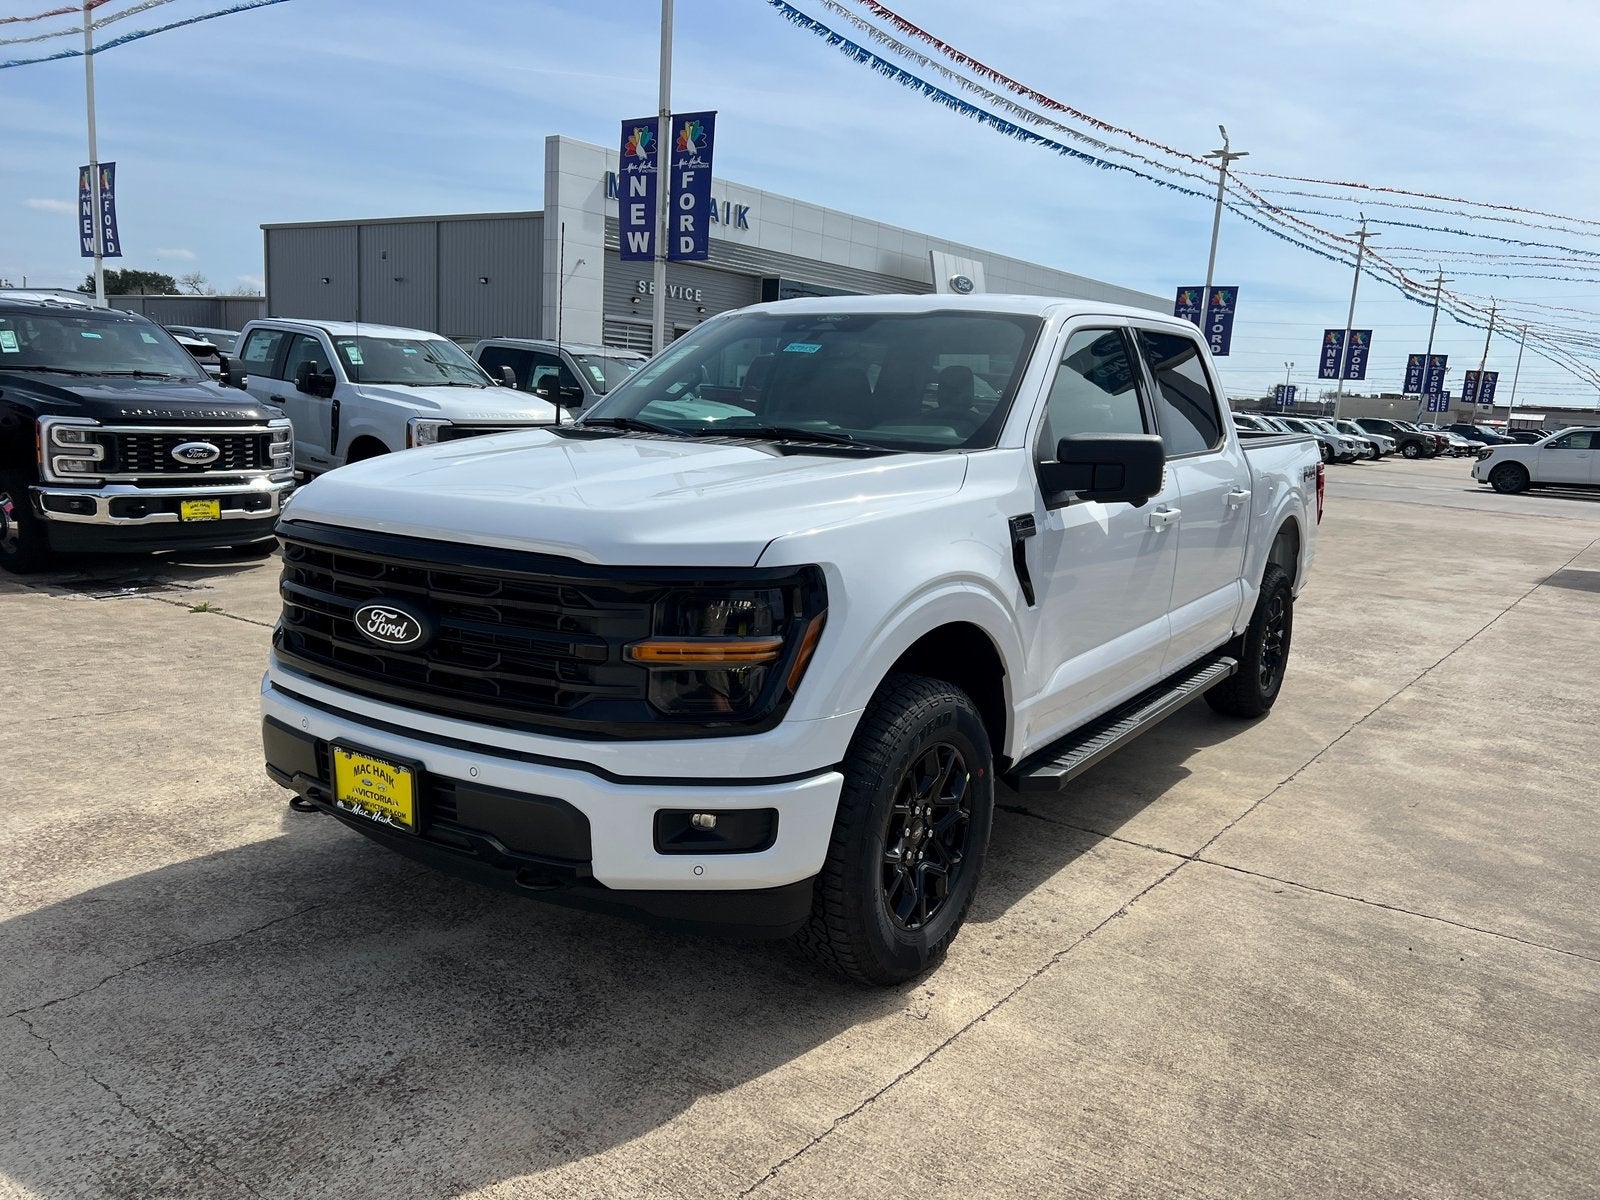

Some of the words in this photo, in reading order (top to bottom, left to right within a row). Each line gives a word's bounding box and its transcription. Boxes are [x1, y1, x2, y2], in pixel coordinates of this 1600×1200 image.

[82, 201, 94, 252] NEW
[627, 175, 650, 253] NEW
[679, 171, 695, 253] FORD
[709, 197, 750, 231] AIK
[104, 201, 115, 253] FORD
[638, 280, 702, 302] SEVICE
[1210, 313, 1225, 353] FORD
[1323, 348, 1336, 377] NEW
[1349, 349, 1362, 378] FORD
[1408, 369, 1419, 391] NEW
[1429, 369, 1439, 393] FORD
[1464, 383, 1474, 401] NEW
[186, 448, 208, 458] Ford
[367, 609, 408, 639] Ford
[353, 764, 371, 777] MAC
[372, 765, 395, 789] HAIK
[348, 803, 371, 818] Mac
[358, 787, 393, 806] VICTORIA
